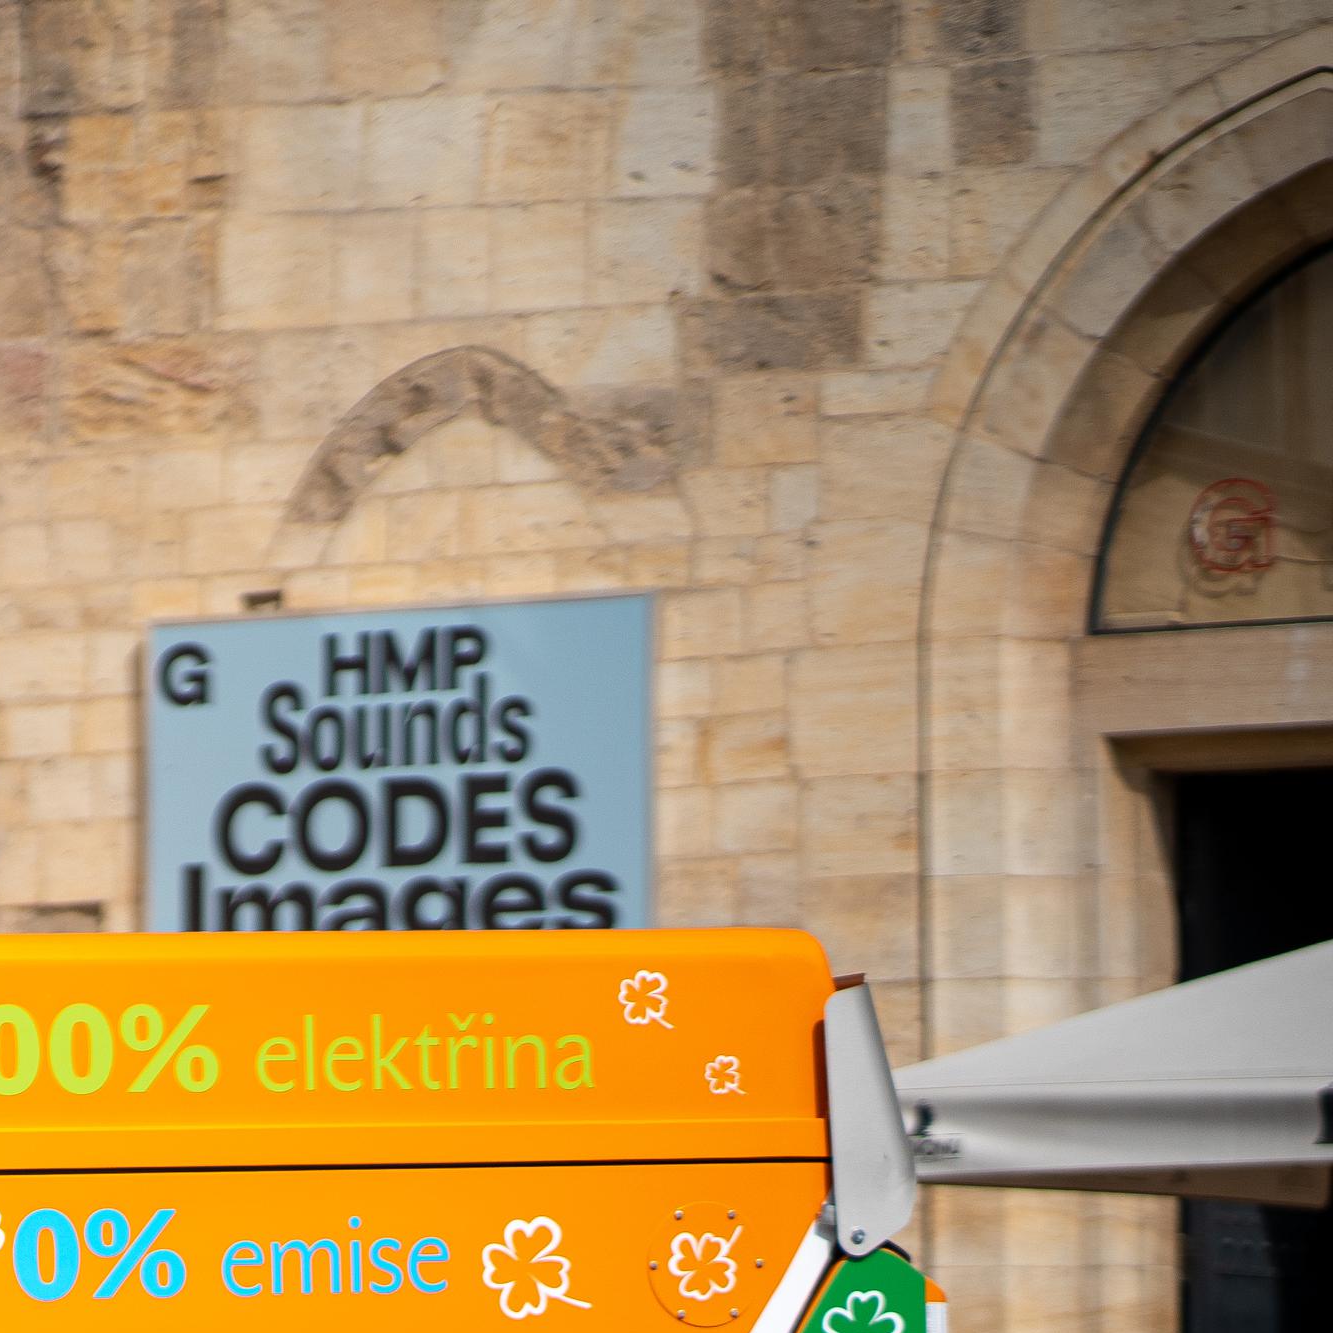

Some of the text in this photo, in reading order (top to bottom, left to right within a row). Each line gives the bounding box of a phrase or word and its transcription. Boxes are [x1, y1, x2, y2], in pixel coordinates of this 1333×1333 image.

[158, 624, 491, 706] G HMP
[260, 672, 534, 774] Sounds
[215, 767, 580, 876] CODES
[181, 863, 620, 932] Images
[254, 1012, 596, 1093] elektřina
[12, 1207, 450, 1302] 0% emise
